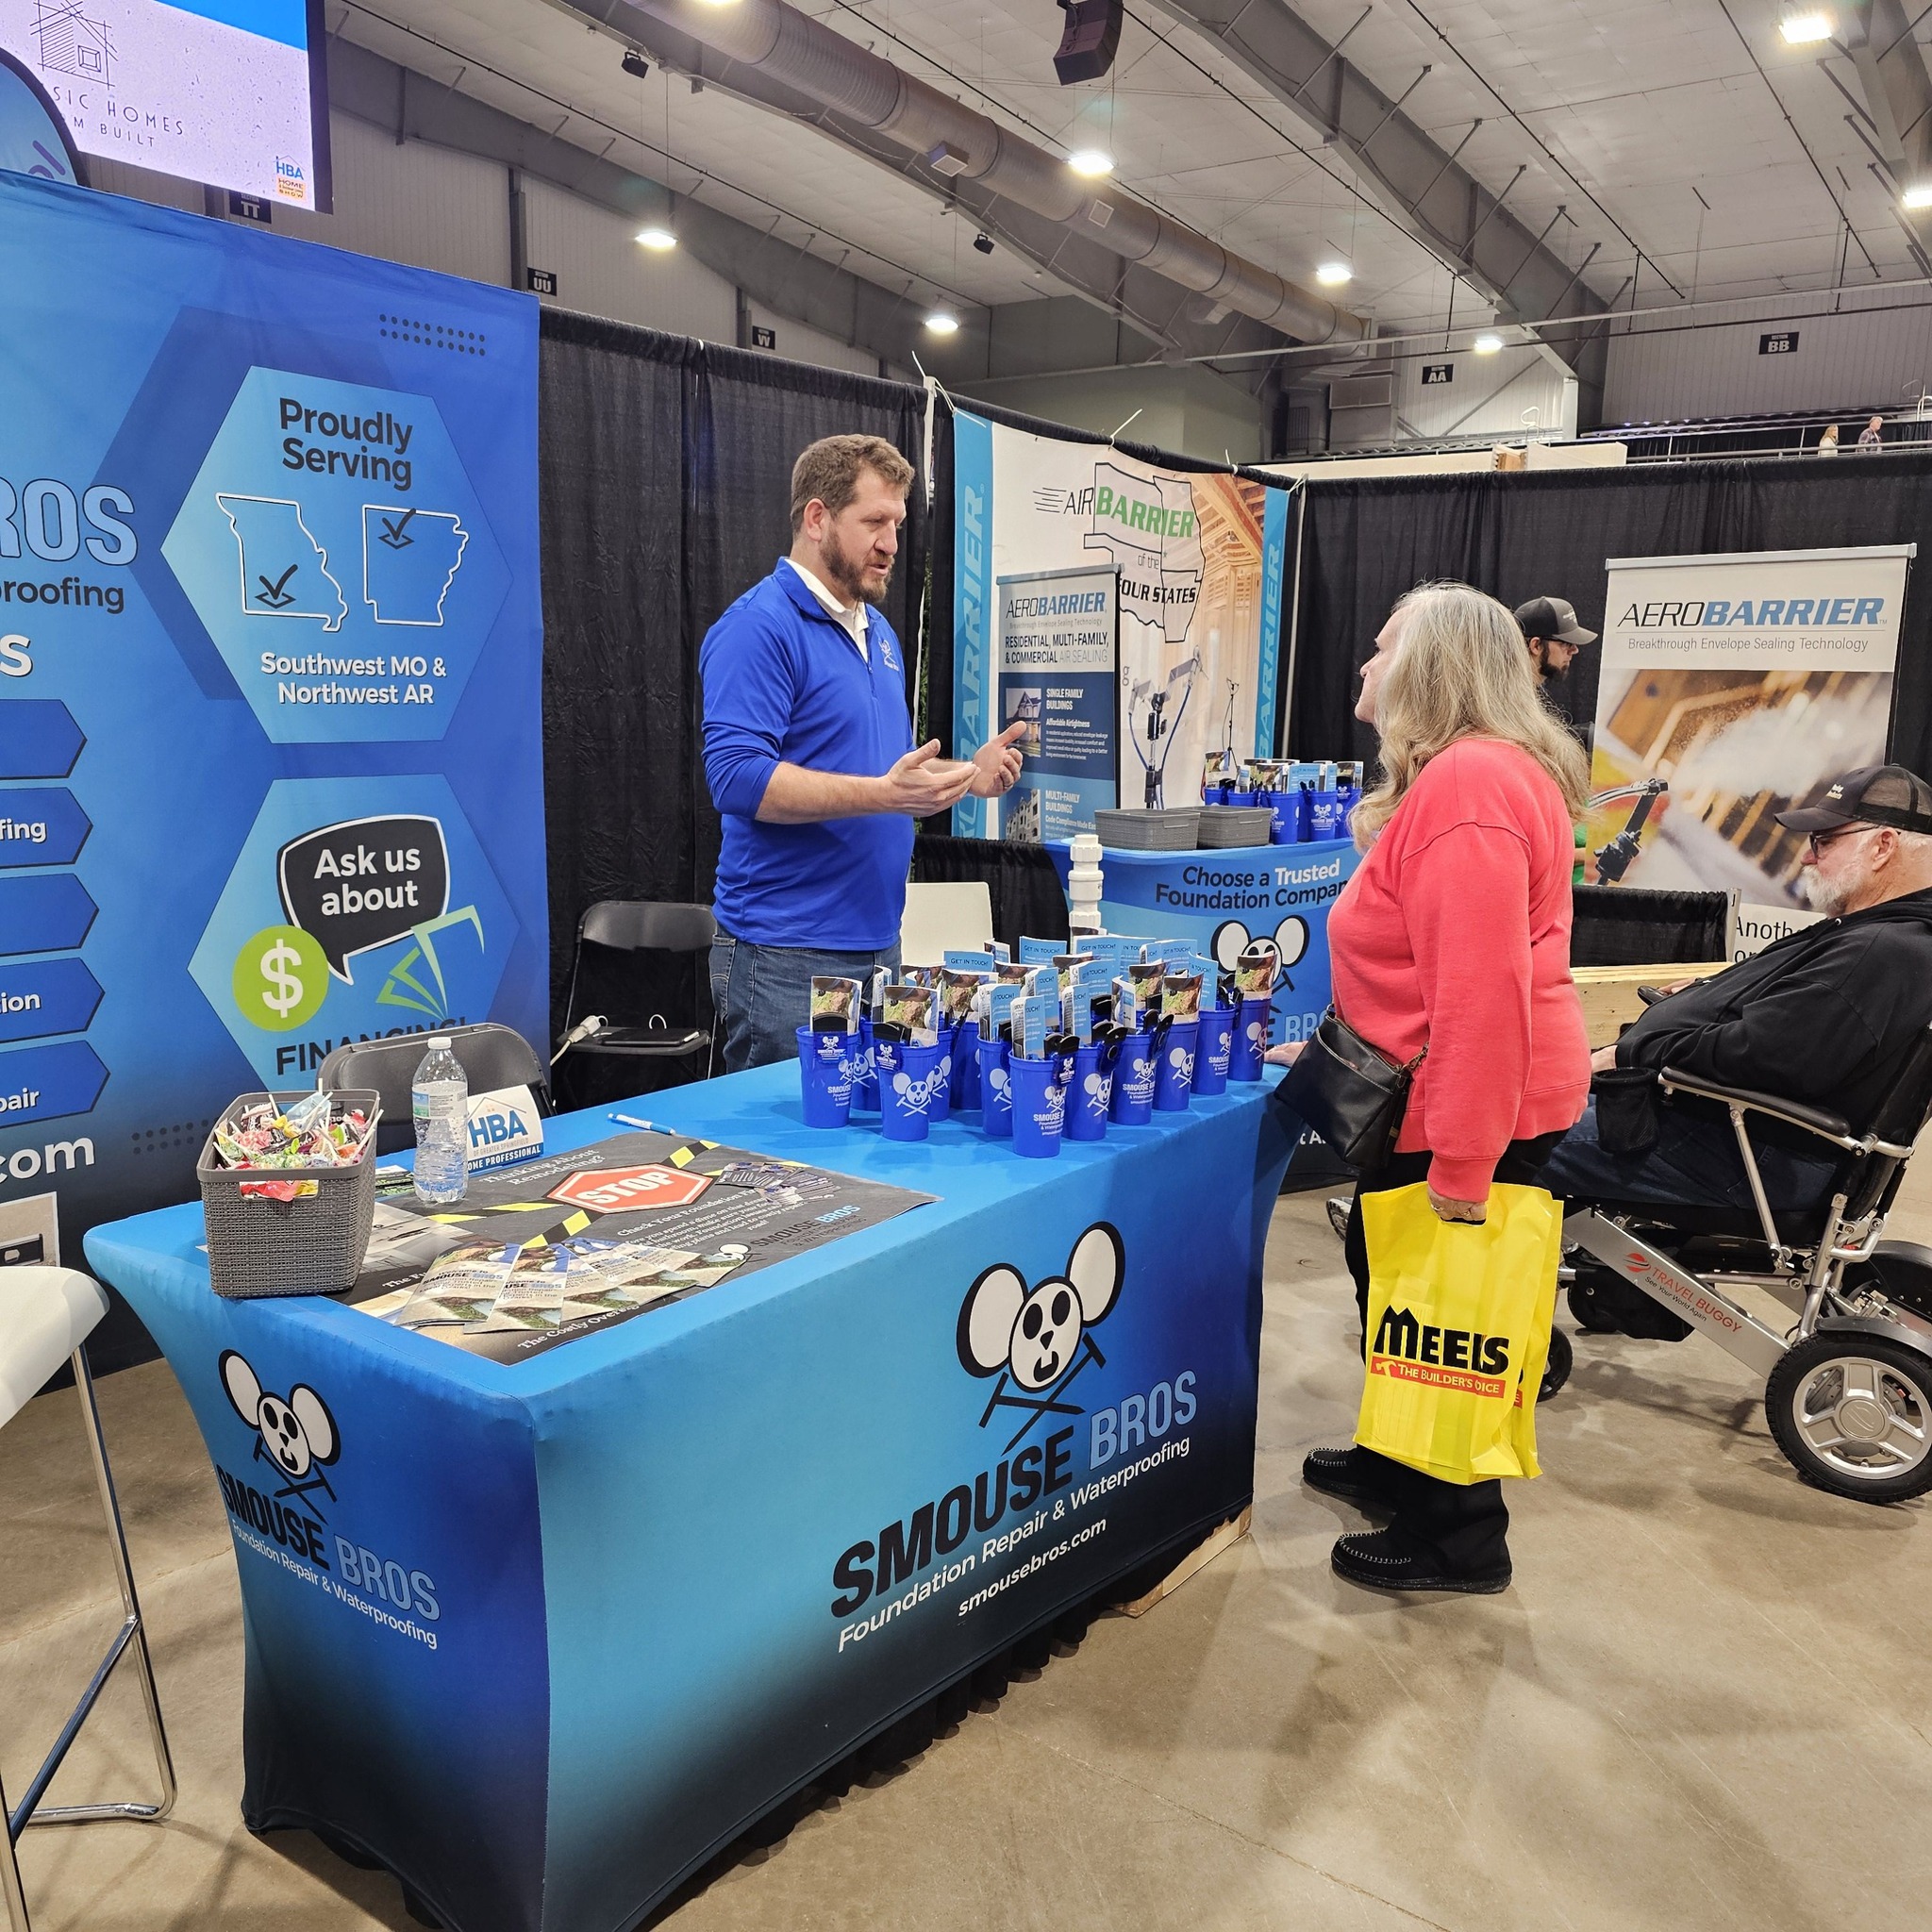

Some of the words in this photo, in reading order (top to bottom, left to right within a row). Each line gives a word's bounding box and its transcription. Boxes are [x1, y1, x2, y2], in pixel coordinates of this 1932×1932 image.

[107, 100, 183, 135] HOMES
[100, 124, 155, 147] BUILT
[275, 160, 304, 180] HBA
[278, 177, 304, 189] HOME
[241, 200, 260, 219] TT
[533, 276, 552, 292] UU
[1767, 340, 1790, 353] BB
[1427, 371, 1447, 383] AA
[278, 397, 413, 455] Proudly
[281, 438, 413, 491] Serving
[1063, 485, 1195, 538] AIRBARRIER
[1137, 553, 1146, 566] of
[1147, 555, 1159, 569] the
[0, 576, 125, 614] roofing
[1119, 577, 1150, 601] OUR
[1152, 586, 1197, 604] STATES
[1006, 591, 1106, 619] AEROBARRIER
[1005, 634, 1051, 649] RESIDENTIAL,
[1053, 631, 1109, 647] MULTI-FAMILY,
[1627, 637, 1697, 650] Breakthrough
[1701, 637, 1751, 652] Envelope
[1753, 637, 1795, 652] Sealing
[1799, 637, 1869, 653] Technology
[260, 651, 386, 676] Southwest
[391, 657, 426, 677] MO
[432, 658, 447, 678] &
[1005, 652, 1010, 663] &
[1011, 651, 1058, 664] COMMERCIAL
[1059, 650, 1071, 662] AIR
[1072, 649, 1108, 663] SEALING
[277, 681, 399, 706] Northwest
[404, 682, 435, 706] AR
[1088, 822, 1097, 830] Eas
[313, 845, 376, 879] Ask
[385, 846, 421, 872] us
[1182, 865, 1255, 888] Choose
[1258, 872, 1270, 887] a
[1274, 858, 1341, 886] Trusted
[321, 879, 419, 915] about
[1156, 883, 1270, 910] Foundation
[1274, 879, 1349, 907] Compan
[1737, 916, 1798, 941] Anoth
[1123, 1083, 1150, 1091] SMOUSE
[468, 1109, 529, 1149] HBA
[1033, 1113, 1061, 1122] SMOUSE
[468, 1157, 486, 1171] OME
[485, 1146, 541, 1167] PROFESSIONAL
[480, 1143, 500, 1155] GREATER
[500, 1137, 529, 1152] SPRINGFIELD
[479, 1161, 557, 1184] Thinking
[554, 1149, 600, 1166] About
[507, 1154, 606, 1185] Remodeling?
[576, 1172, 675, 1204] STOP
[617, 1221, 656, 1237] Check
[651, 1213, 682, 1225] Your
[680, 1193, 742, 1216] Foundation
[697, 1216, 743, 1236] Foundation
[750, 1220, 822, 1247] SMOUSE
[814, 1205, 861, 1224] BROS
[645, 1231, 664, 1240] you
[663, 1221, 690, 1234] spend
[382, 1275, 411, 1289] The
[1644, 1275, 1657, 1288] See
[1658, 1285, 1673, 1297] Your
[1673, 1294, 1690, 1310] World
[1690, 1307, 1707, 1322] Again
[1653, 1267, 1695, 1302] TRAVEL
[1695, 1297, 1742, 1333] BUGGY
[518, 1335, 548, 1349] The
[547, 1321, 589, 1338] Costly
[1398, 1363, 1419, 1379] THE
[1421, 1370, 1474, 1389] BUILDER'S
[830, 1424, 1074, 1618] SMOUSE
[1089, 1369, 1198, 1471] BROS
[216, 1464, 330, 1571] SMOUSE
[333, 1533, 441, 1622] BROS
[837, 1557, 975, 1653] Foundation
[981, 1509, 1049, 1563] Repair
[1052, 1499, 1065, 1522] &
[1070, 1436, 1191, 1510] Waterproofing
[958, 1517, 1108, 1617] smousebros.com
[232, 1518, 281, 1566] Foundation
[281, 1551, 319, 1587] Repair
[322, 1575, 332, 1594] &
[331, 1580, 438, 1650] Waterproofing
